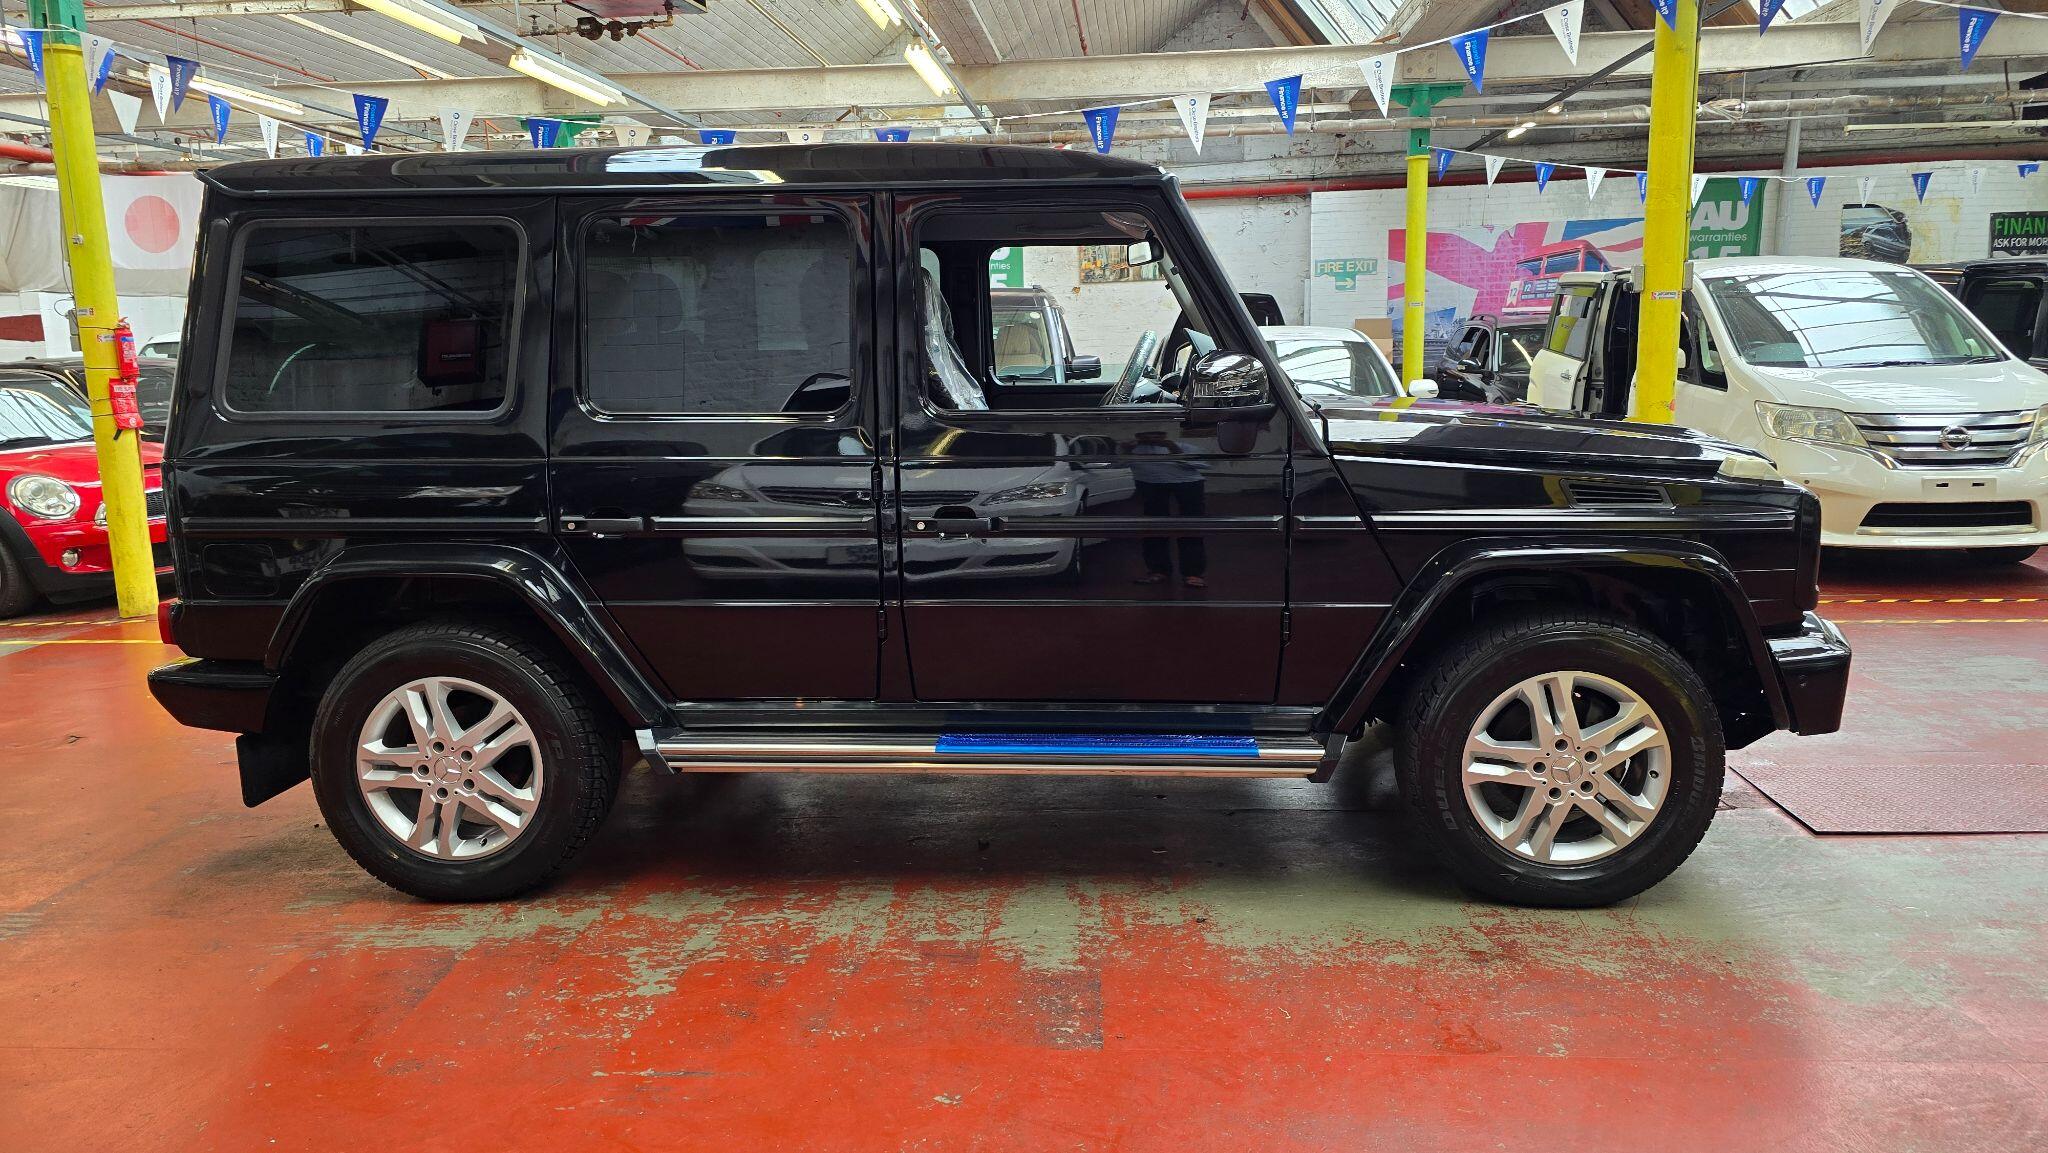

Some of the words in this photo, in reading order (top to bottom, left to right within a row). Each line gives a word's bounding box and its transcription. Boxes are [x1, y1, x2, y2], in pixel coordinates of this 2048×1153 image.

[1464, 42, 1474, 66] Finance
[1994, 217, 2046, 236] FINAN
[1993, 238, 2010, 248] ASK
[2010, 238, 2027, 247] FOR
[1317, 262, 1344, 273] FIRE
[1346, 260, 1376, 272] EXIT
